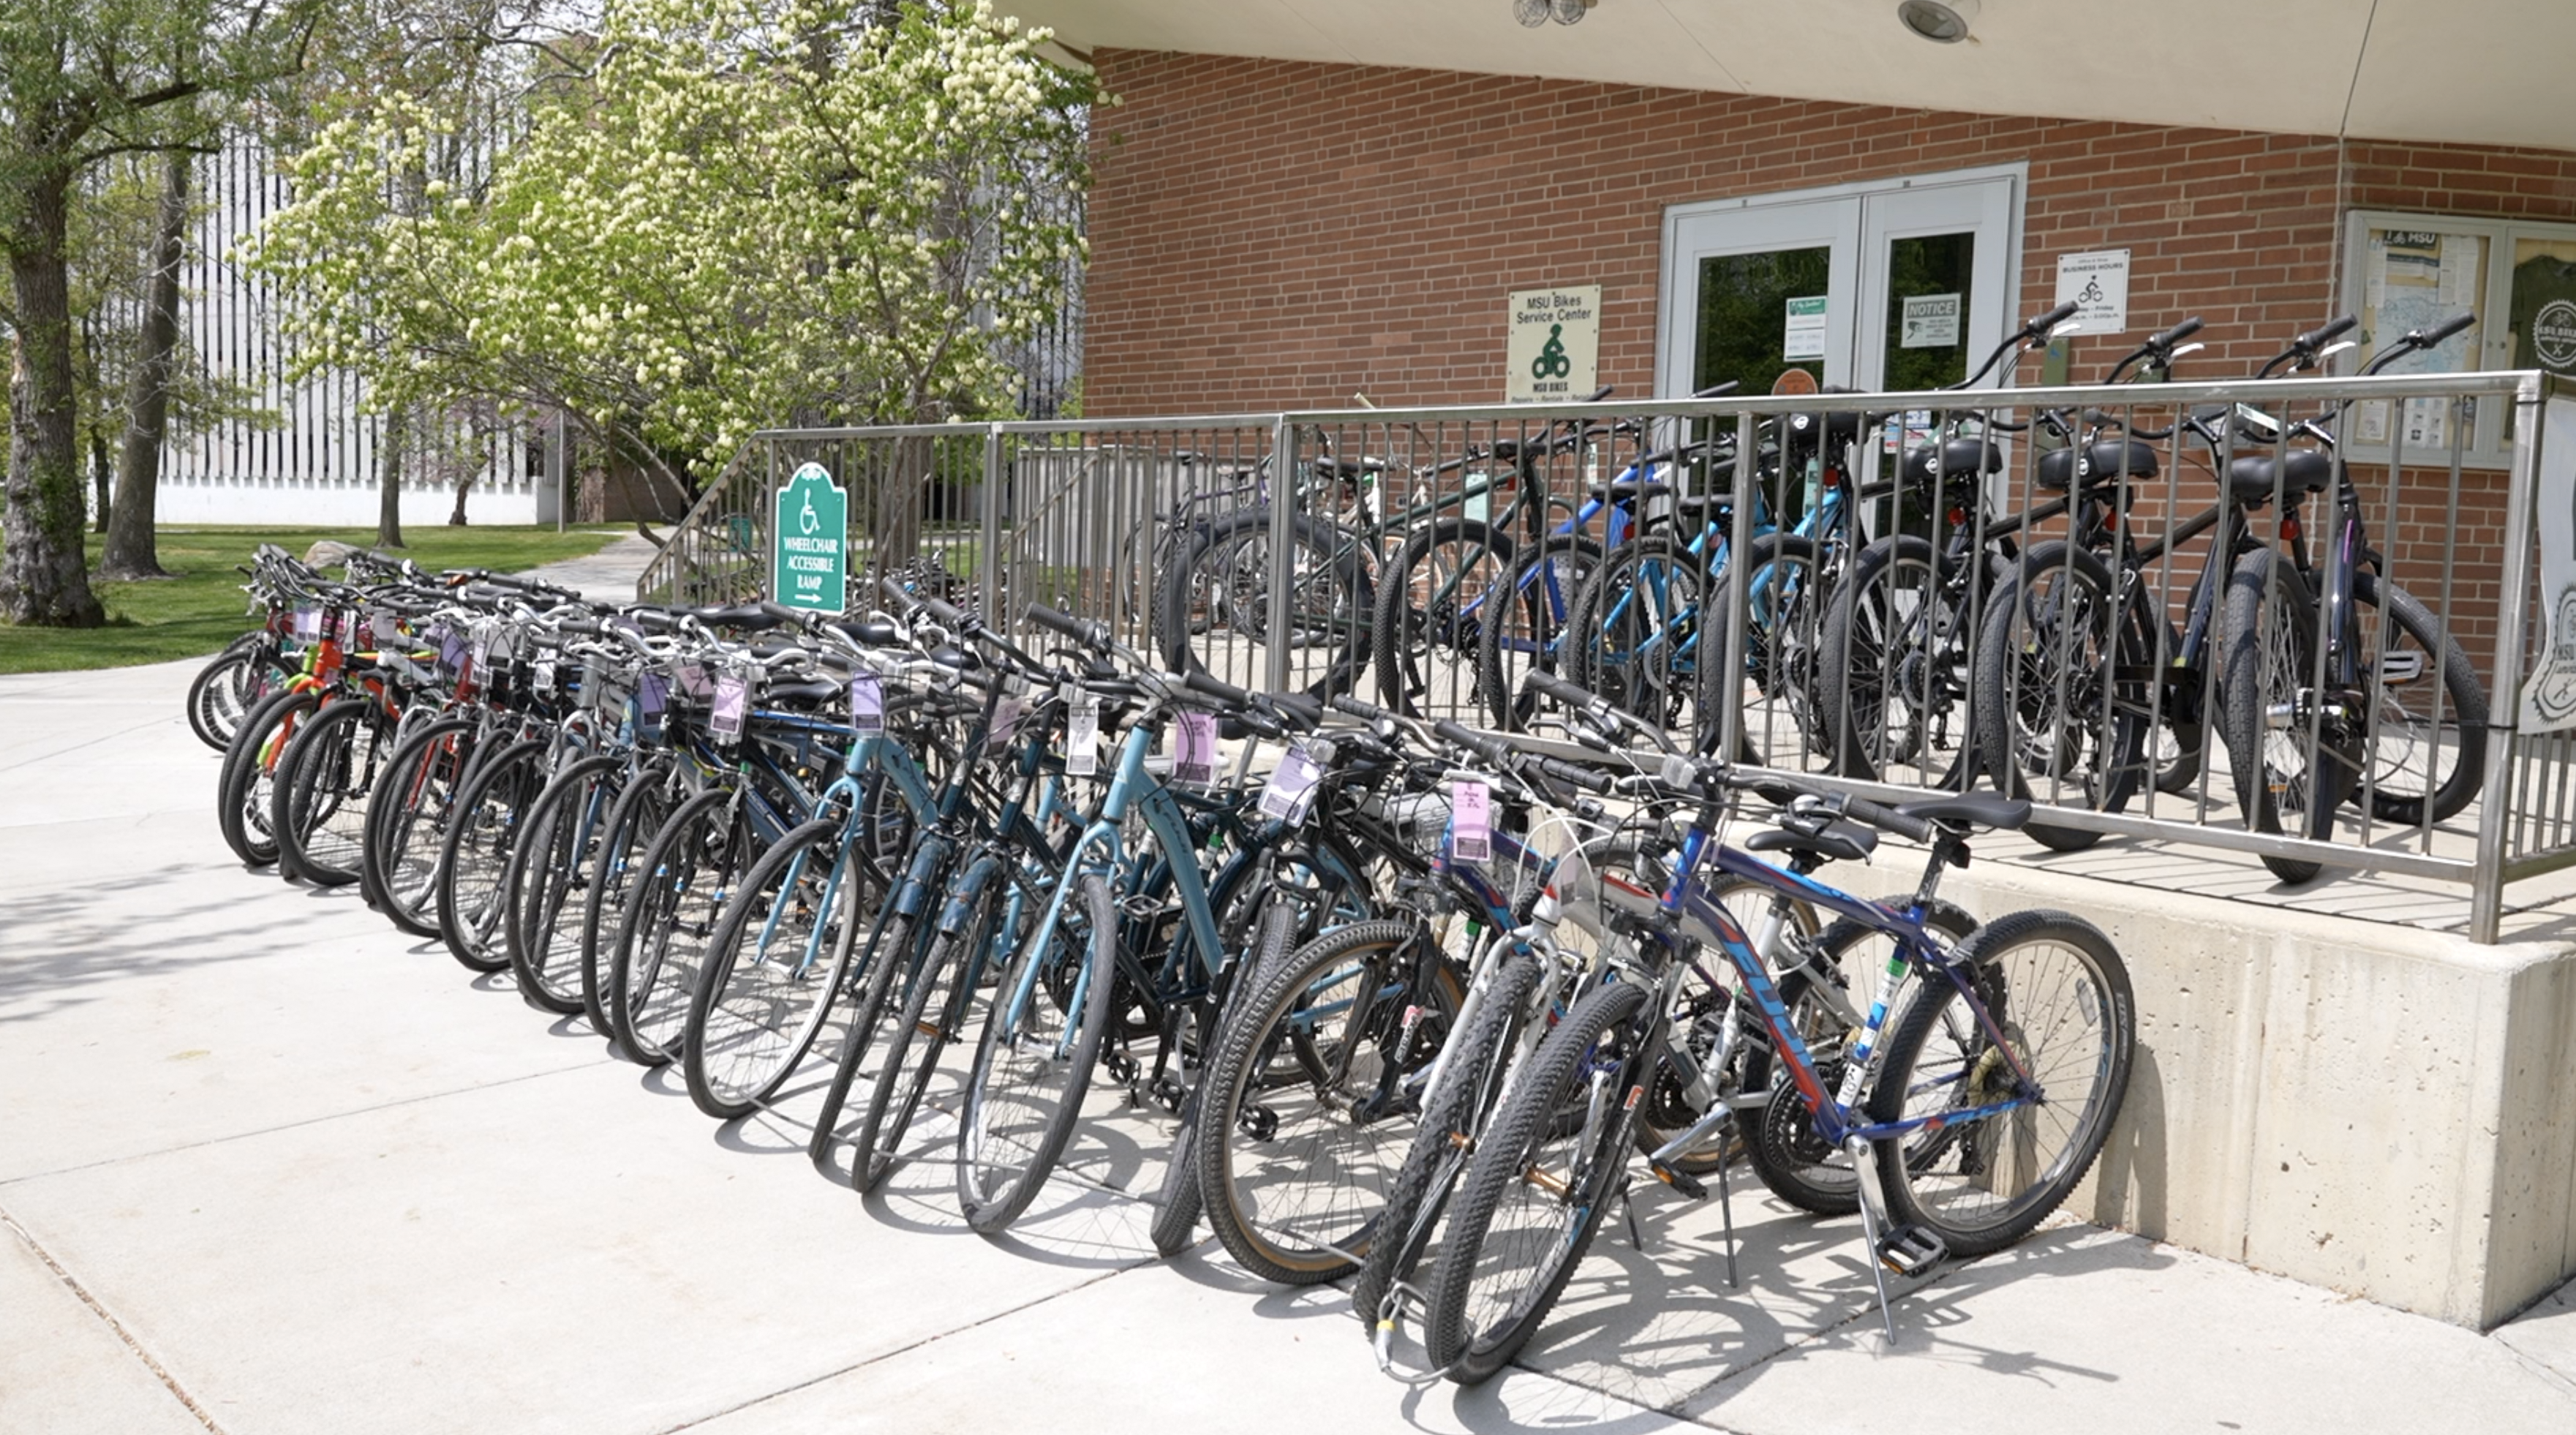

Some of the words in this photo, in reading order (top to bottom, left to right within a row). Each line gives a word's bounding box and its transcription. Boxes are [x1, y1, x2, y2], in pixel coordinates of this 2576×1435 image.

[2409, 232, 2436, 244] MSU
[2098, 263, 2123, 271] HOURS
[1527, 296, 1550, 309] MSU
[1553, 295, 1581, 308] Bikes
[1908, 301, 1954, 317] NOTICE
[1516, 312, 1553, 324] Service
[1557, 308, 1591, 321] Center
[1533, 383, 1547, 392] MSU
[1549, 382, 1568, 392] BIKES
[783, 537, 837, 554] WHEELCHAIR
[786, 556, 834, 573] ACCESSIBLE
[797, 574, 822, 590] RAMP
[1723, 941, 1813, 1067] FUJI
